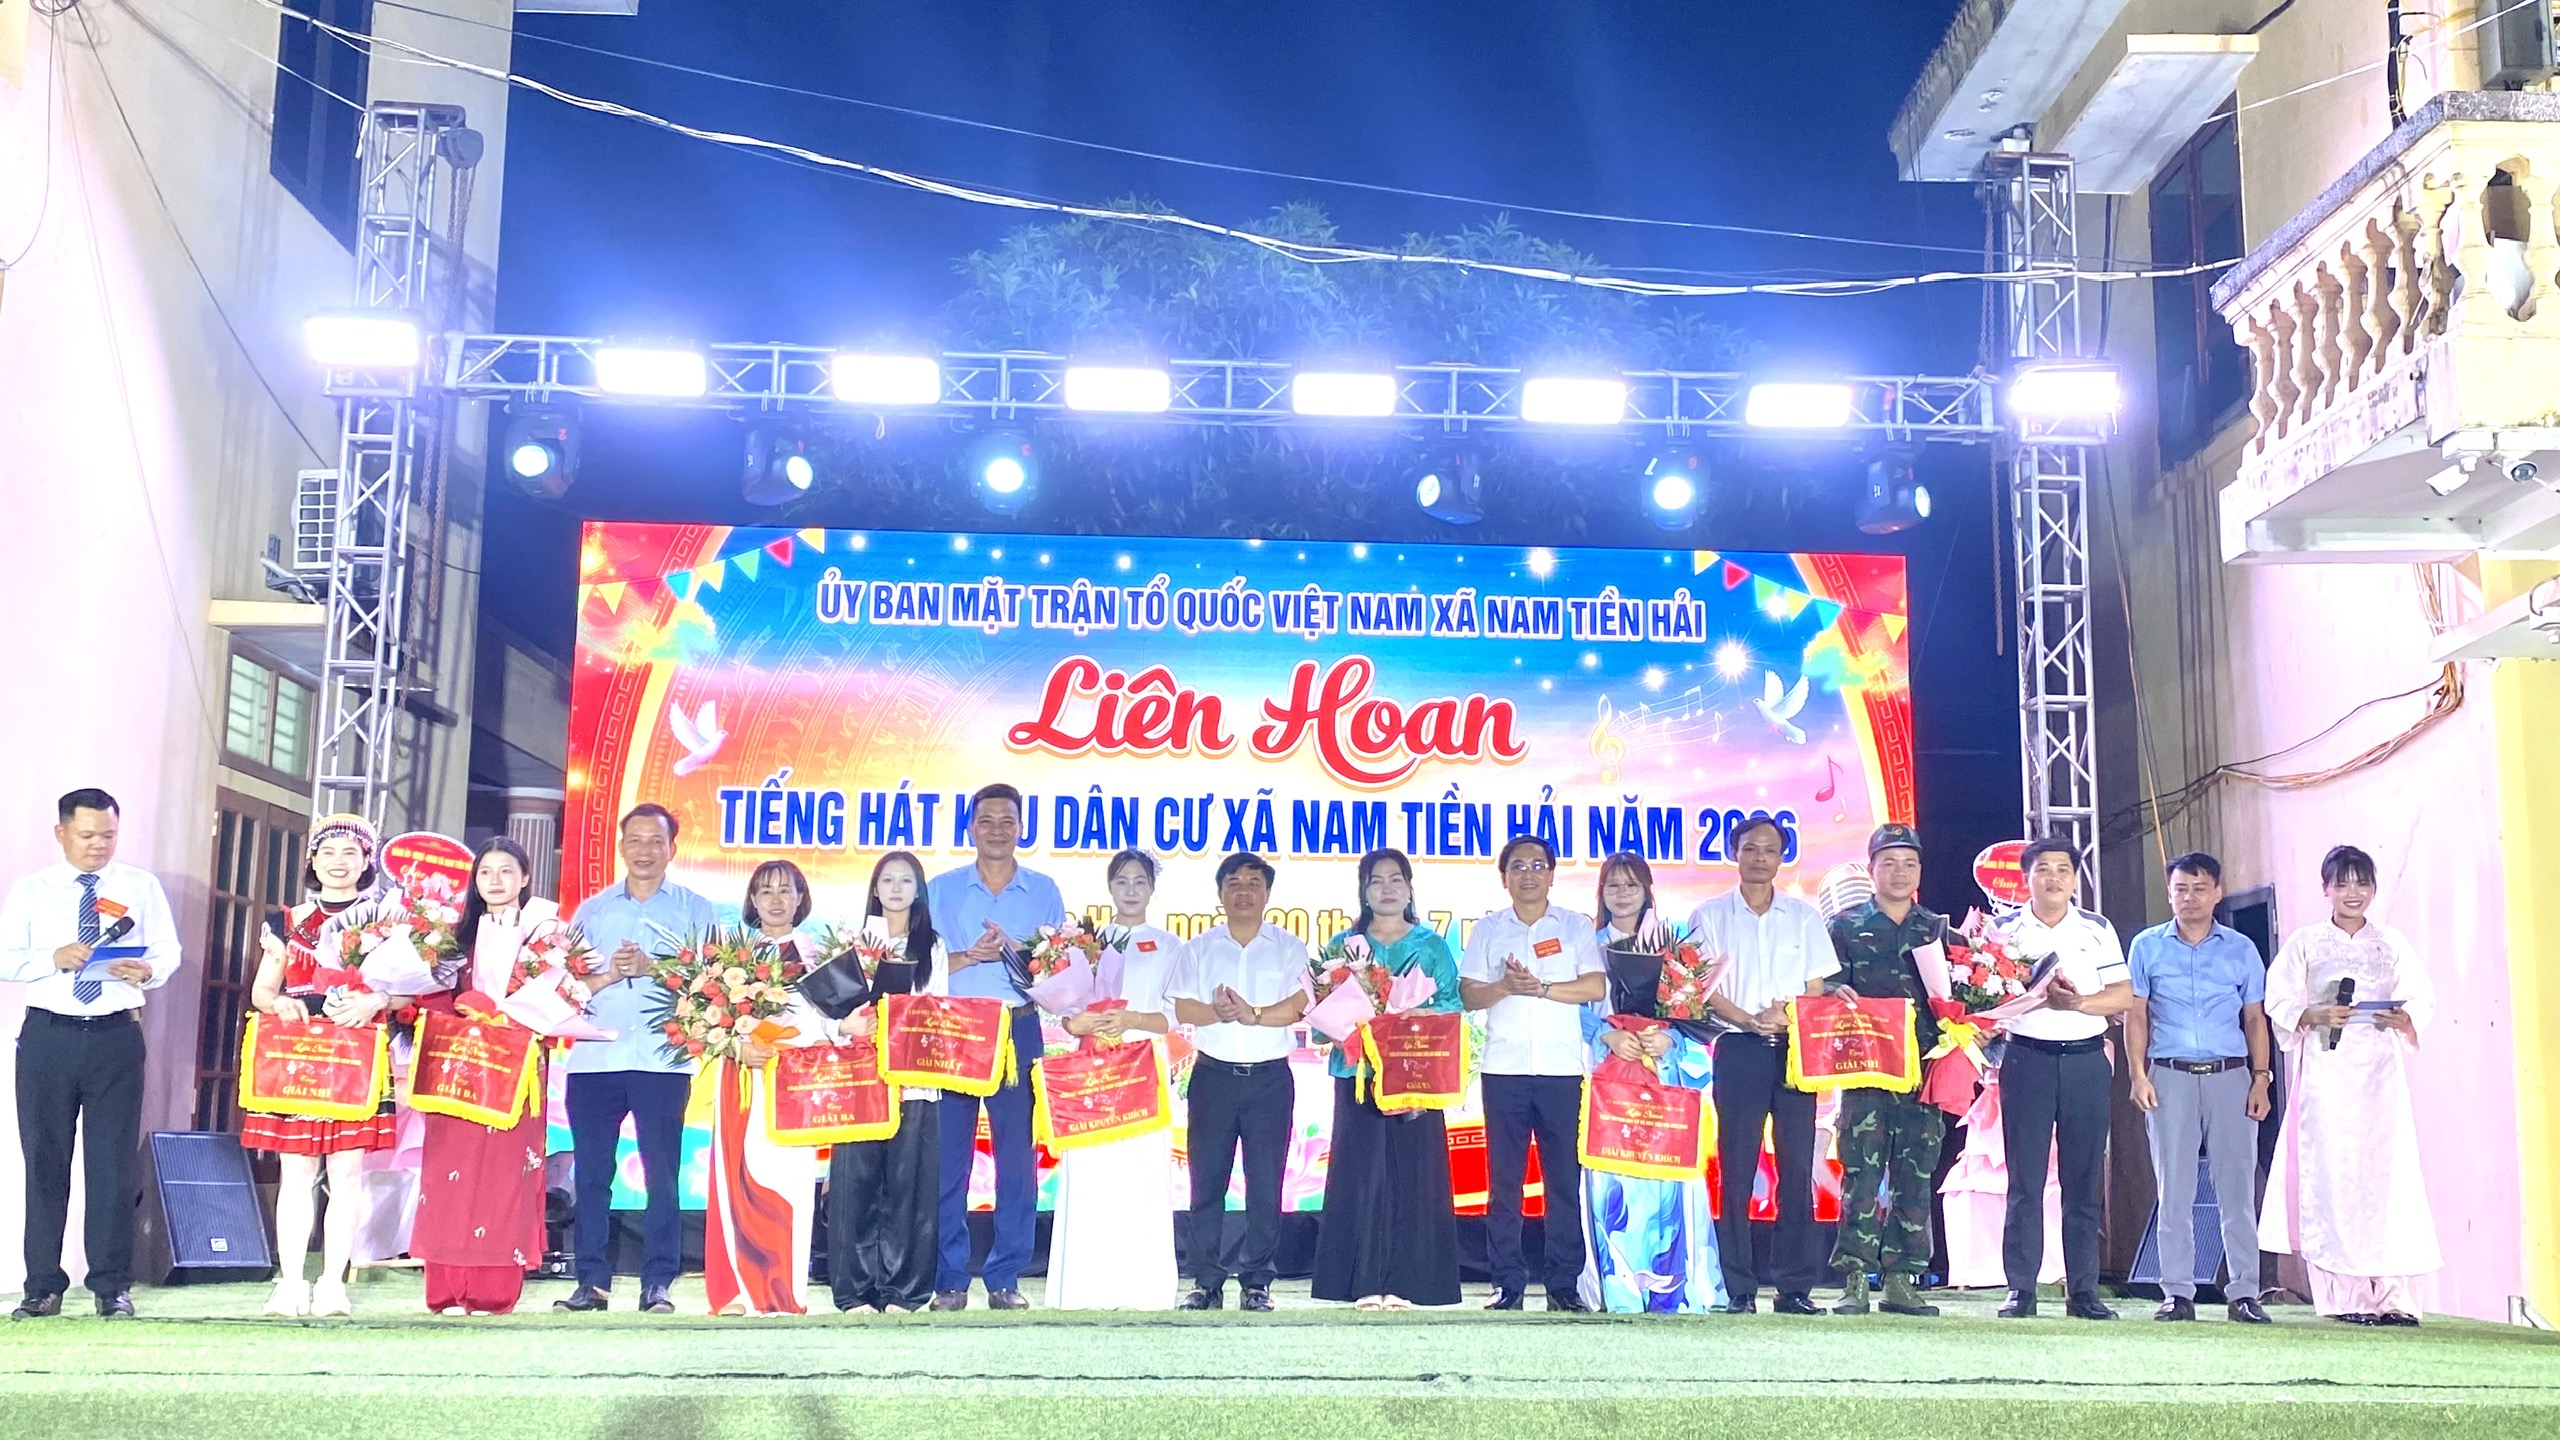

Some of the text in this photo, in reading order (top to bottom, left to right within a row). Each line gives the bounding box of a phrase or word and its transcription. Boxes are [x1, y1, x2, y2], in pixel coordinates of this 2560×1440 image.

[820, 571, 1703, 638] ỦY BAN MẶT TRẬN TỔ QUỐC VIỆT NAM XÃ NAM TIỀN HẢI
[1007, 657, 1527, 784] Liên Hoan
[719, 769, 1798, 864] TIẾNG HÁT KU DÂN CƯ XÃ NAM TIỀN HẢI NĂM 206
